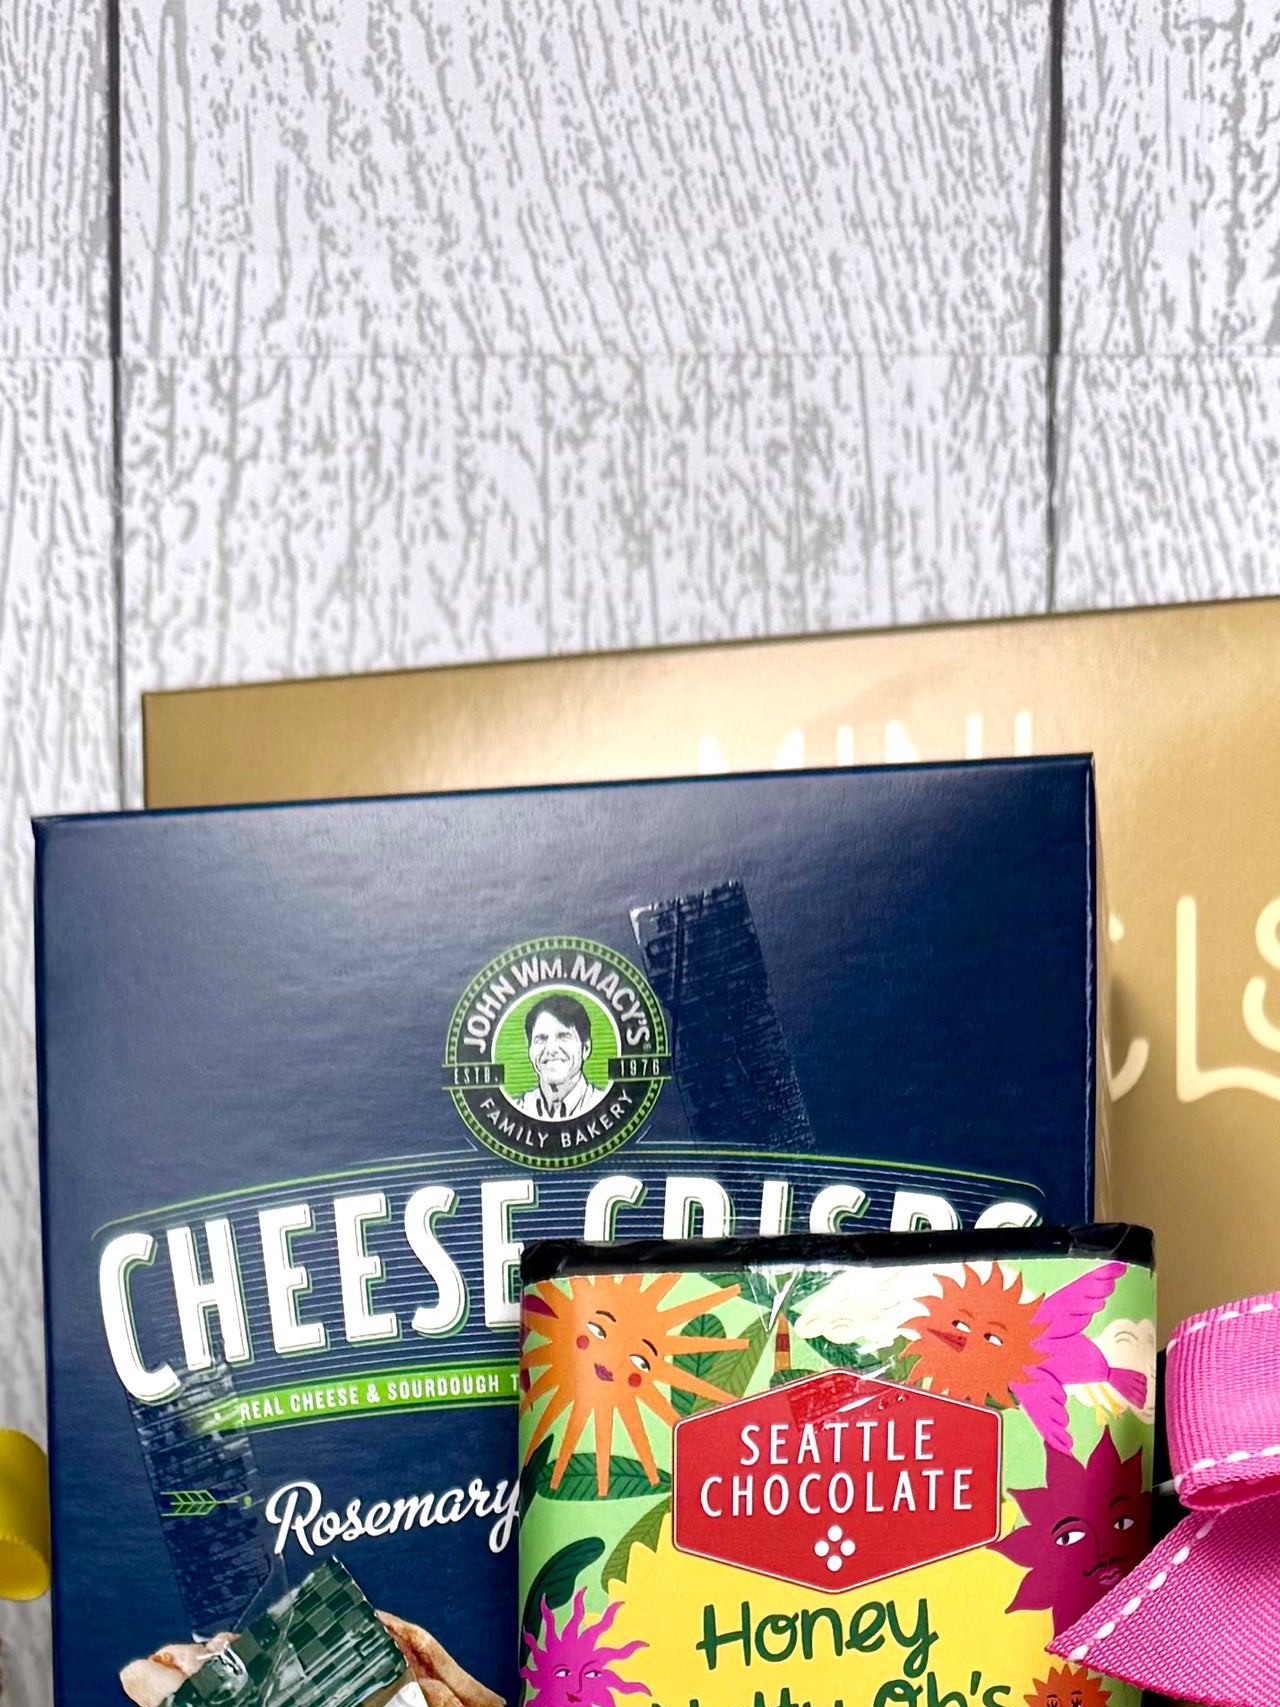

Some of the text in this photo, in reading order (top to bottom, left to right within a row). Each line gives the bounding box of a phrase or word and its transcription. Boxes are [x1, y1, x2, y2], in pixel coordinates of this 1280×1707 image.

[463, 975, 517, 1055] JOHN
[570, 954, 652, 1047] MACY'S
[454, 1059, 660, 1085] ESTB. 1976
[480, 1088, 633, 1149] FAMILY BAKERY
[98, 1178, 537, 1403] CHEESE
[240, 1400, 284, 1421] REAL
[290, 1386, 359, 1413] CHEESE
[366, 1382, 381, 1404] &
[387, 1374, 500, 1401] SOURDOUGH
[740, 1419, 935, 1466] SEATTLE
[265, 1477, 520, 1557] Rosemary
[699, 1468, 973, 1518] CHOCOLATE
[695, 1597, 939, 1677] Honey
